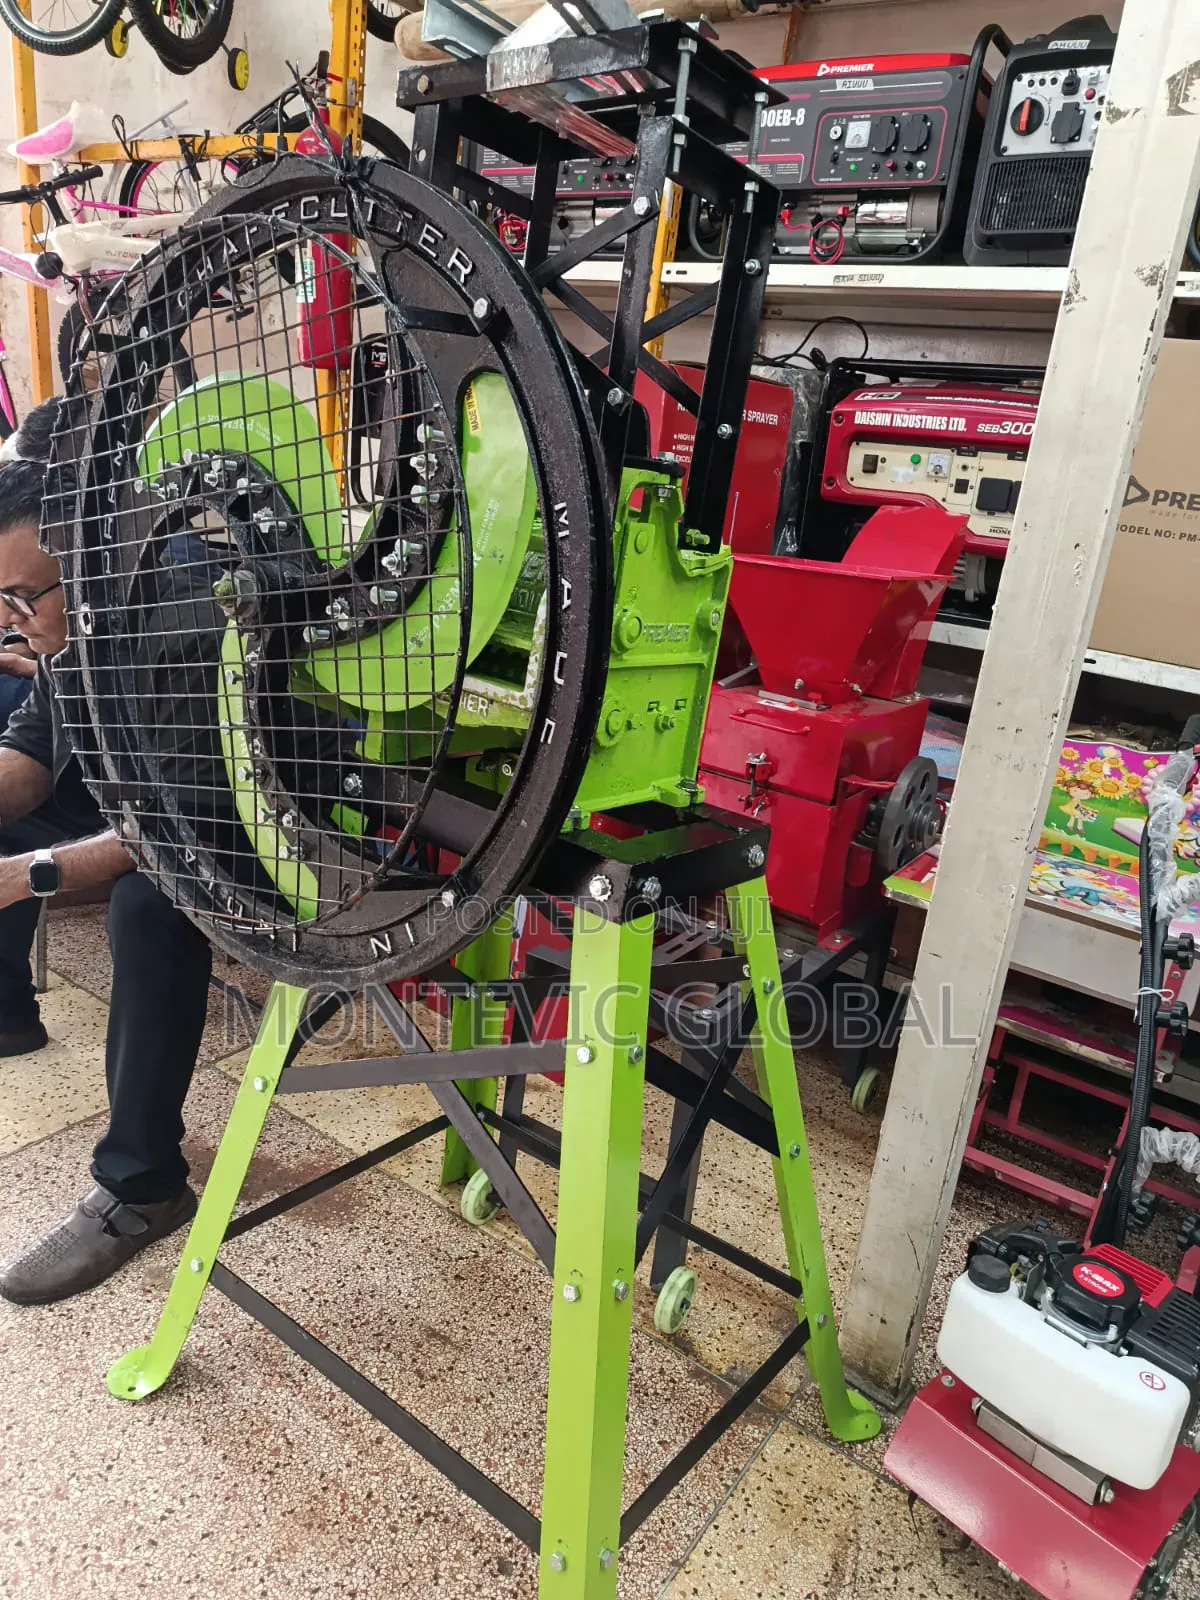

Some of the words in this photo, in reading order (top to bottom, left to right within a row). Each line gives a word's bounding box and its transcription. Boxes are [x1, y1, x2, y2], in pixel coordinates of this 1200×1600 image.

[831, 64, 875, 74] PREMIER
[748, 410, 778, 425] SPRAYER
[854, 411, 892, 426] DAISHIN
[893, 413, 948, 430] INDUSTRIES
[949, 417, 967, 432] LTD.
[1154, 529, 1176, 539] NO:
